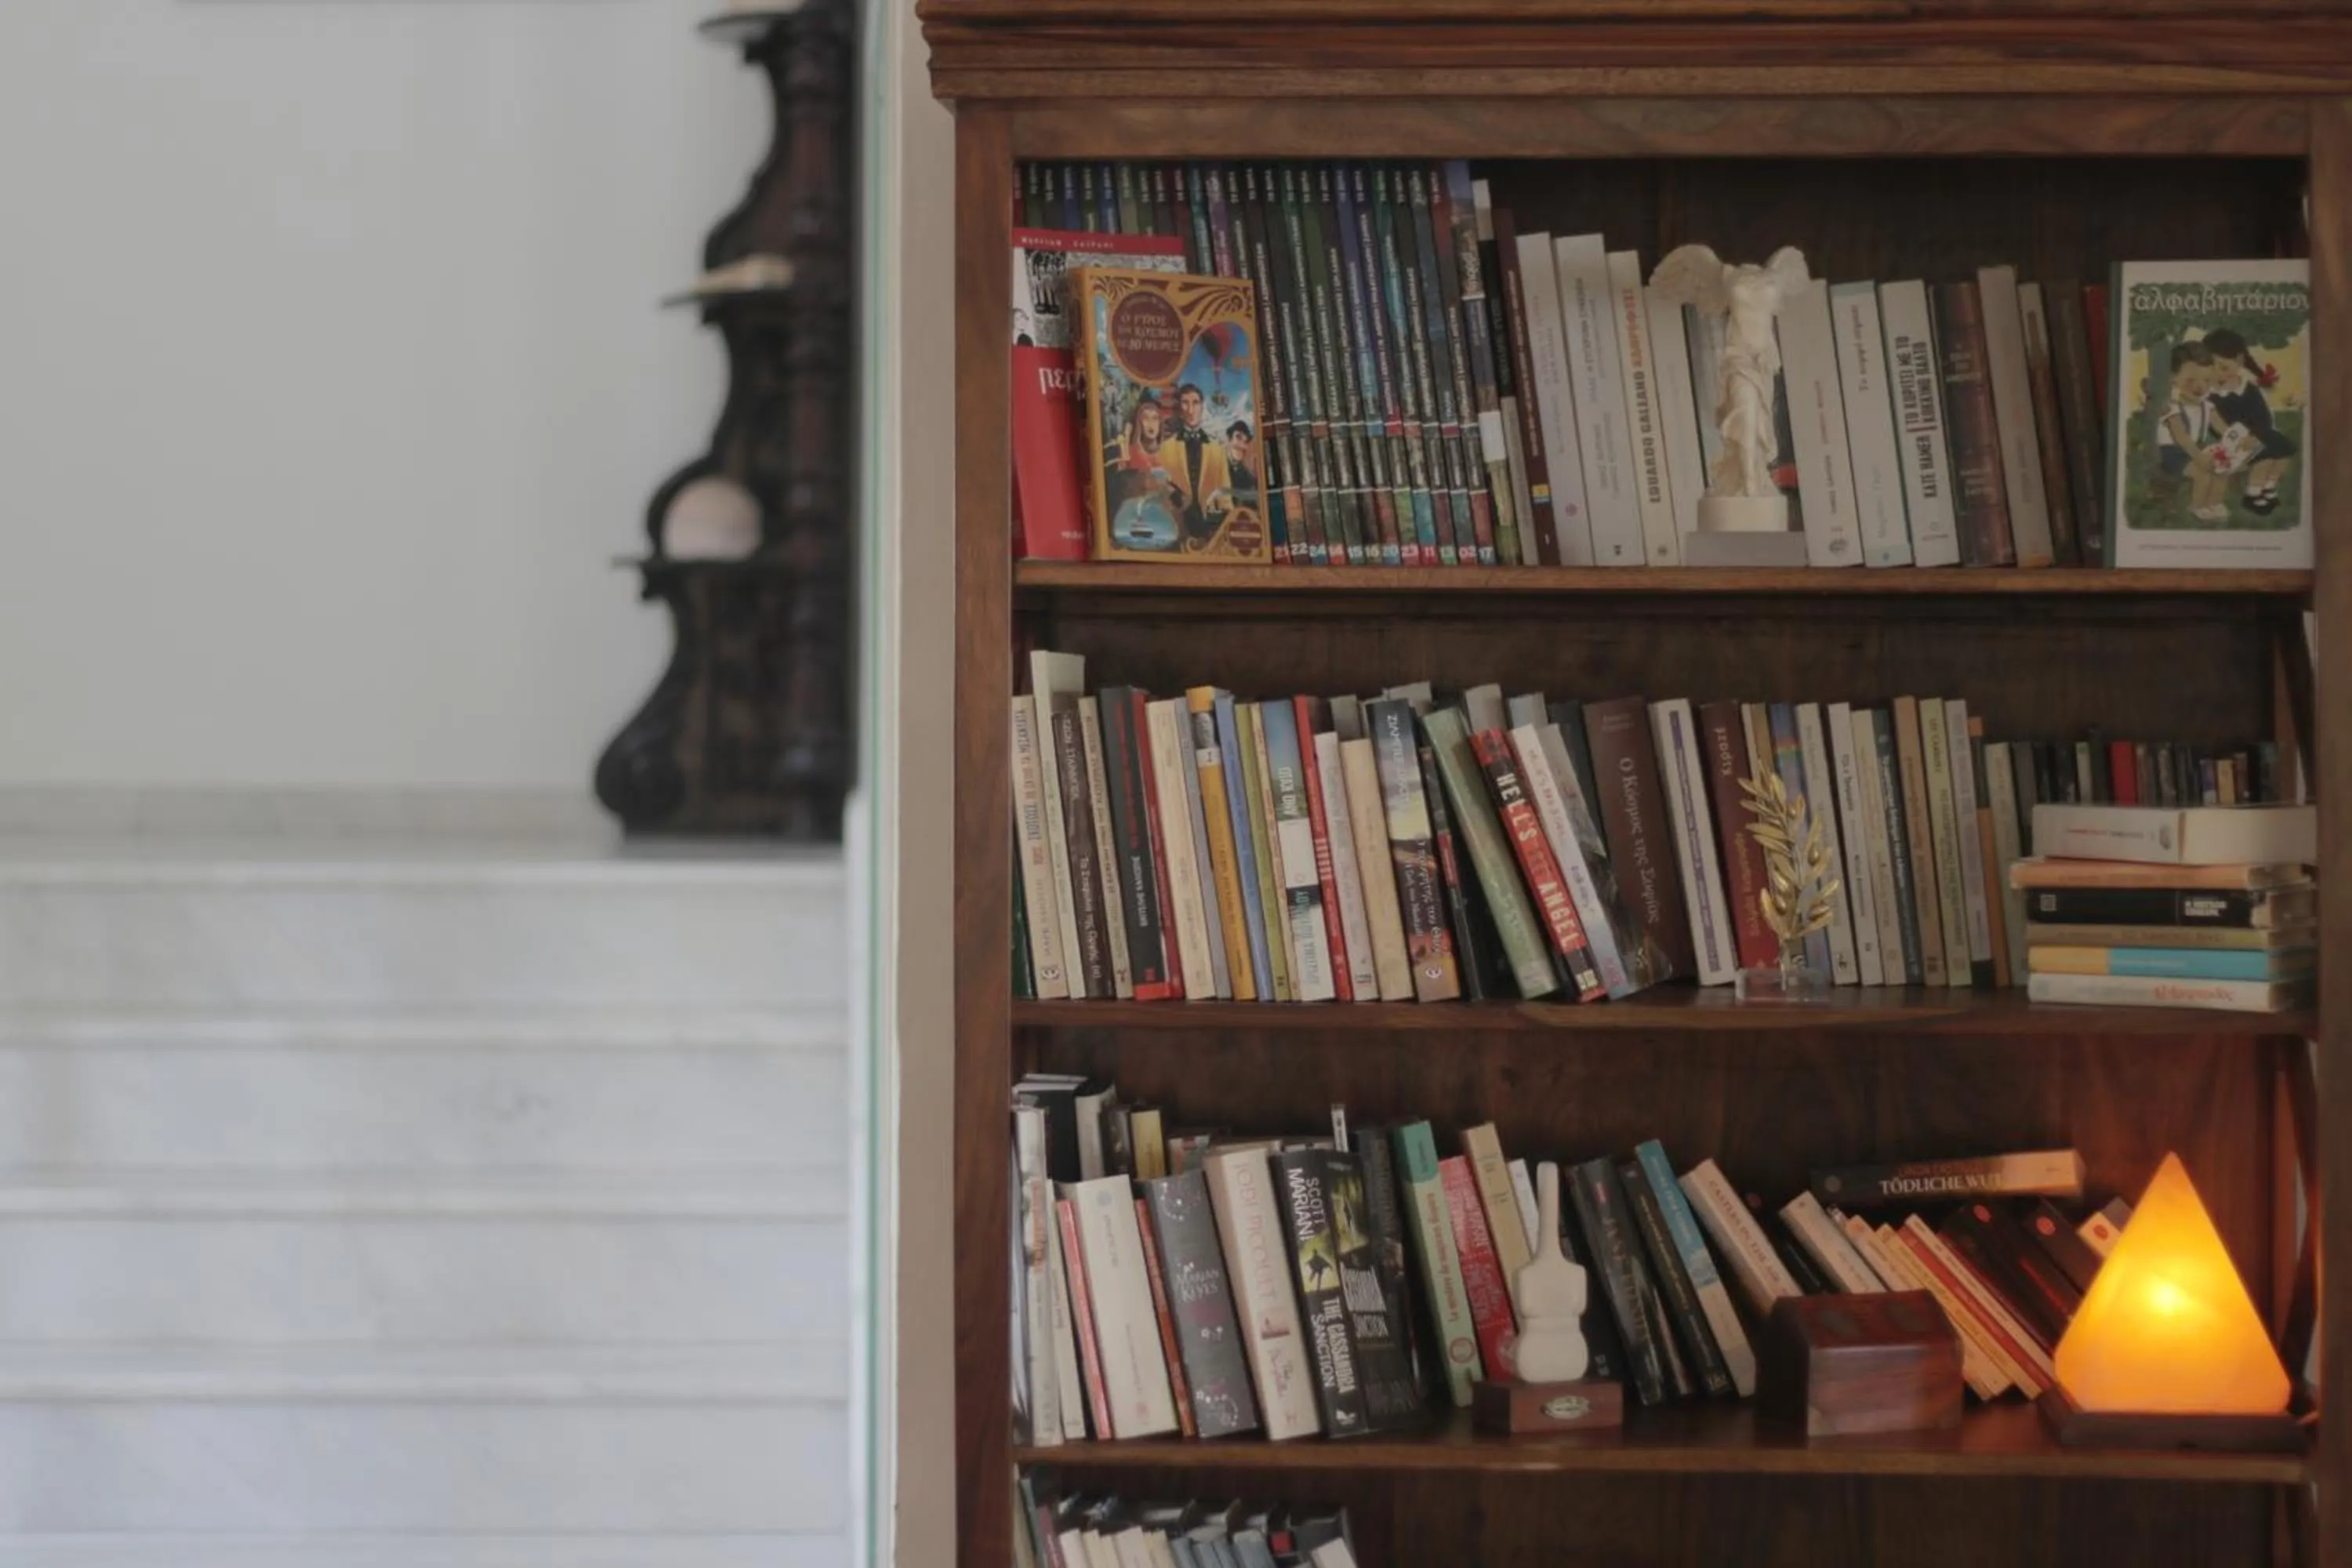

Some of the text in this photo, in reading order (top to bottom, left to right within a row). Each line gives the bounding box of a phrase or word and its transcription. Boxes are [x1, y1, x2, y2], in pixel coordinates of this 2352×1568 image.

[1537, 881, 1579, 949] ANGEL
[1287, 1168, 1314, 1242] MARIANI
[1304, 1177, 1326, 1224] SCOTT
[1878, 1174, 1964, 1196] TÖDLICHE
[1310, 1314, 1336, 1388] SANCTION
[1321, 1298, 1356, 1393] THE CASSANDRA
